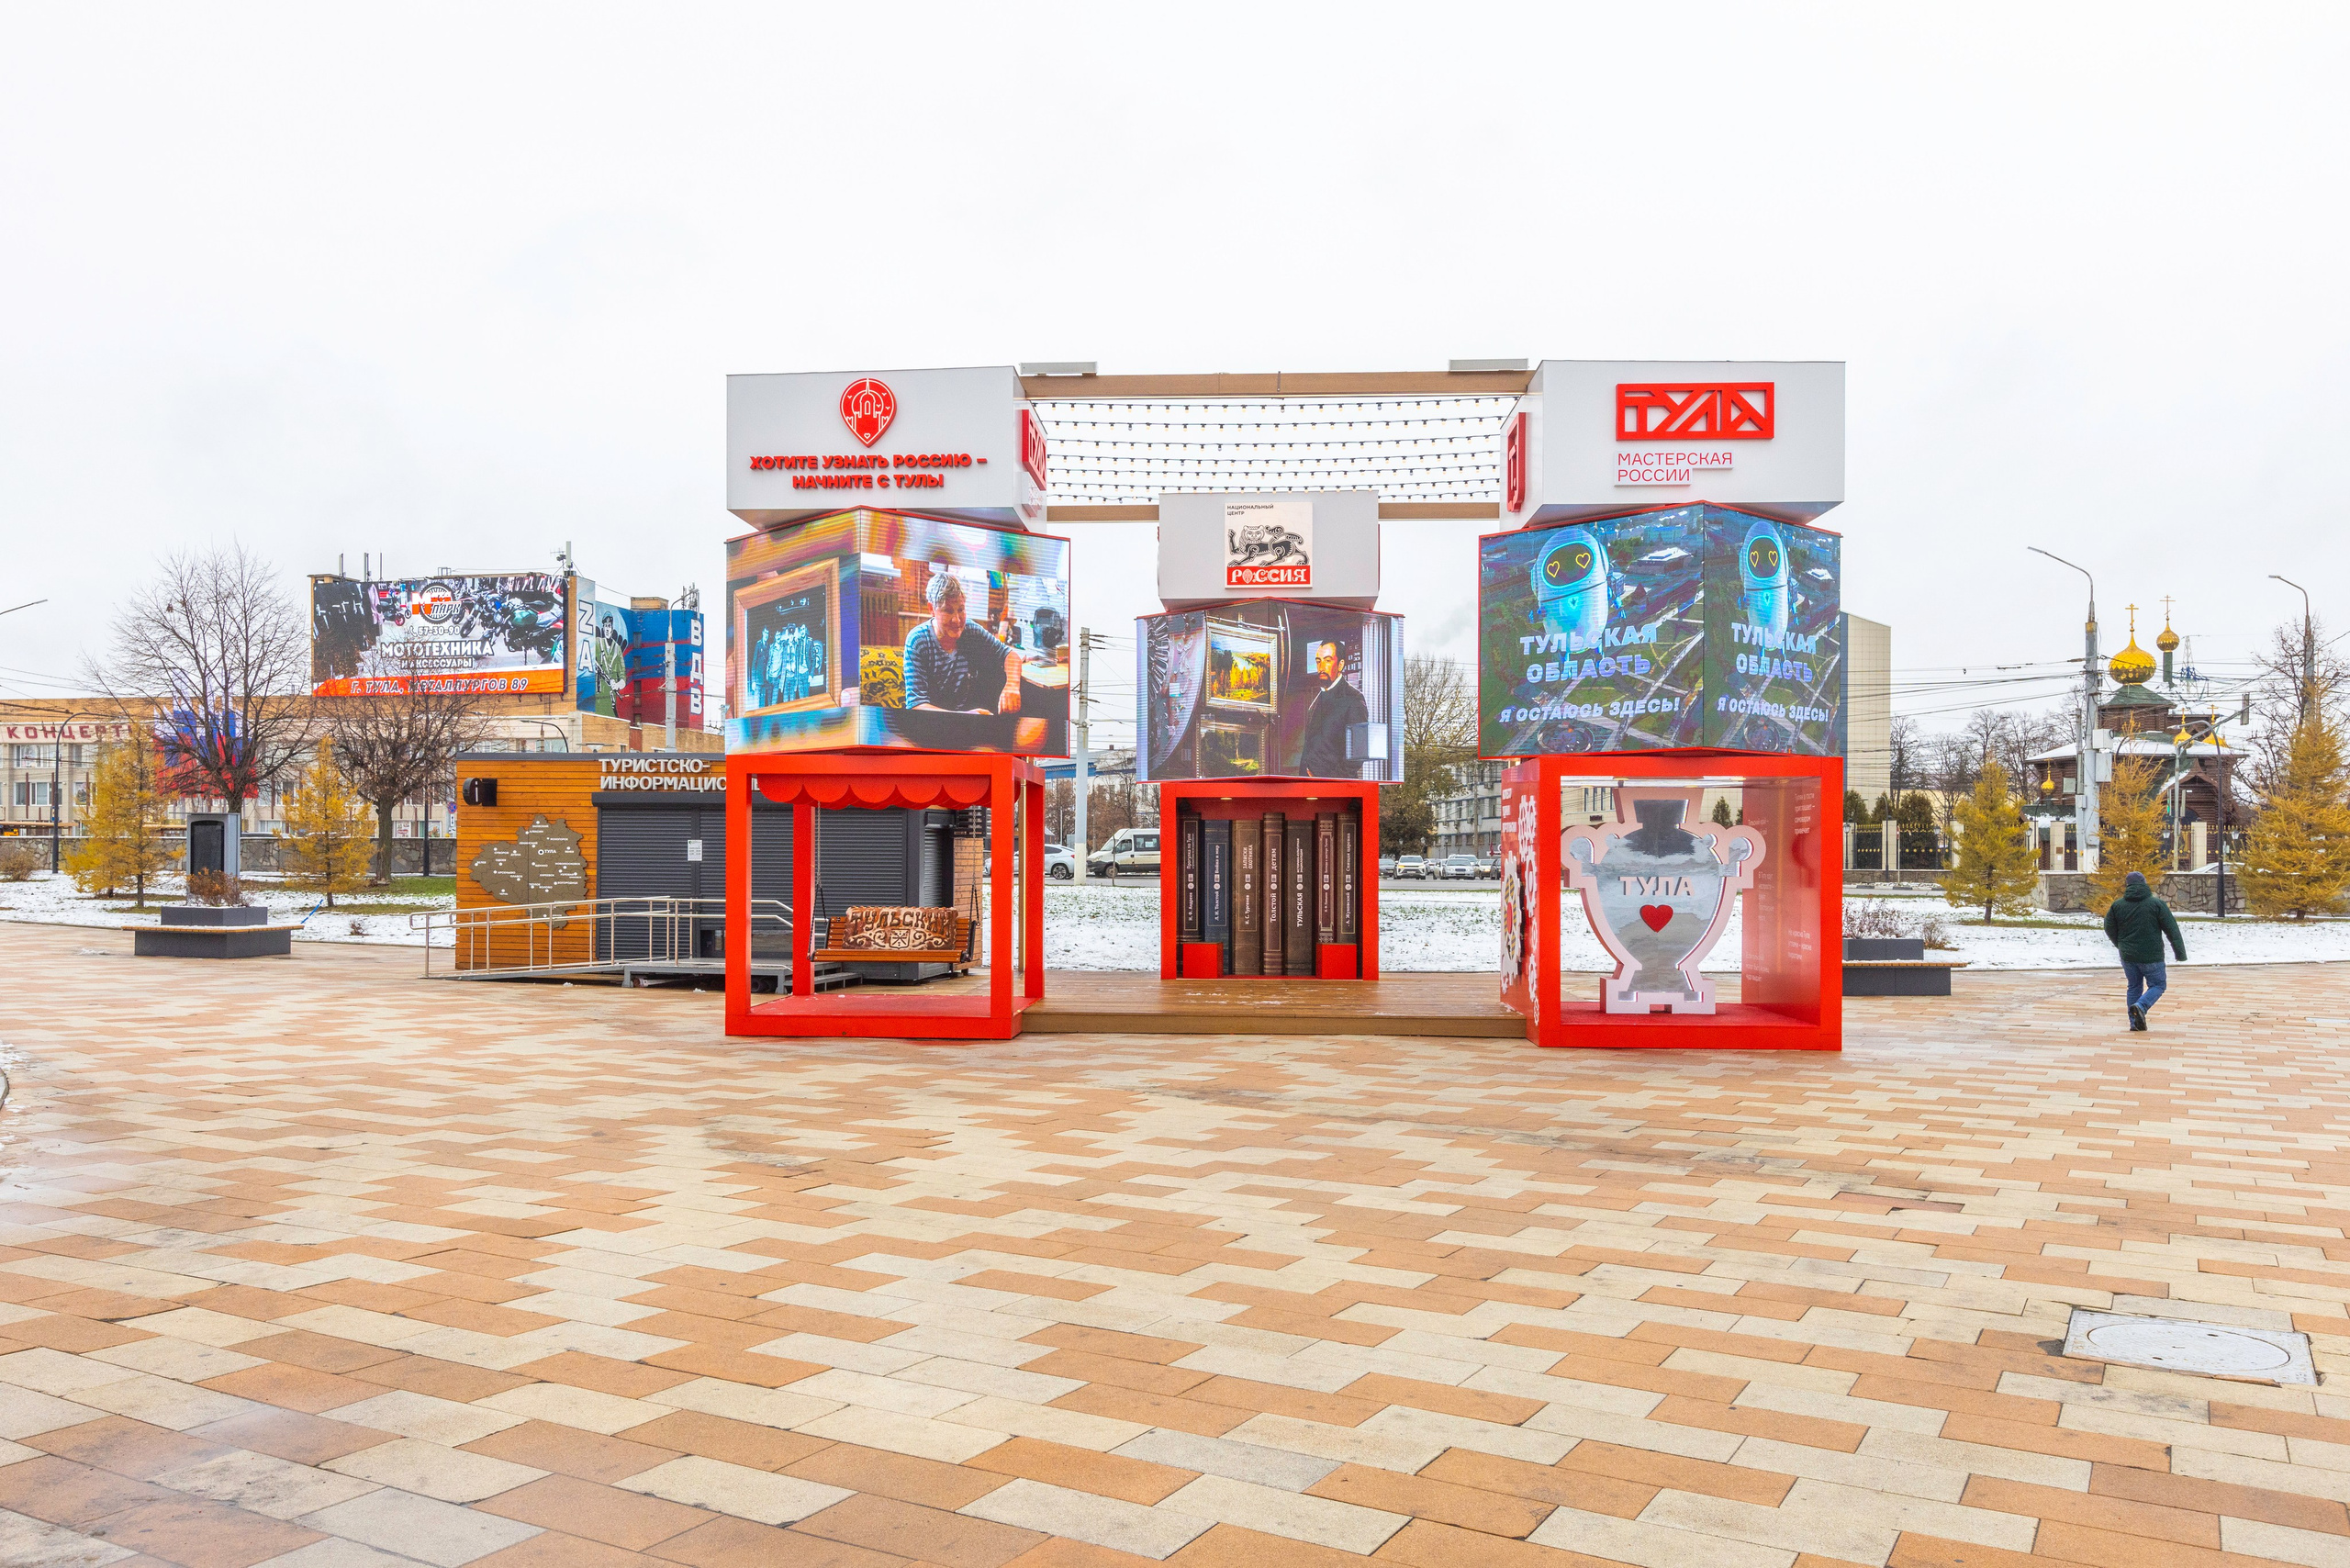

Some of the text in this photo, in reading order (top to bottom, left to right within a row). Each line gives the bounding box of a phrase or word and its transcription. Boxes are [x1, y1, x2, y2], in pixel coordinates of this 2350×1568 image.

[750, 455, 818, 471] ХОТИТЕ
[822, 454, 889, 470] УЗНАТЬ
[893, 454, 972, 468] РОССИЮ
[1617, 452, 1733, 465] МАСТЕРСКАЯ
[792, 474, 945, 489] НАЧНИТЕ С ТУЛЫ
[1617, 468, 1691, 482] РОССИИ
[1230, 568, 1307, 585] РОССИЯ
[418, 626, 460, 636] 57-30-90
[1520, 623, 1658, 655] ТУЛЬСКАЯ
[1731, 622, 1817, 655] ТУЛЬСКАЯ
[380, 641, 495, 657] МОТОТЕХНИКА
[408, 657, 472, 669] АКСЕССУАРЫ
[1527, 655, 1651, 684] ОБЛАСТЬ
[1736, 653, 1813, 682] ОБЛАСТЬ
[366, 679, 404, 694] ТУЛА,
[408, 678, 509, 694] МЕТАЛЛУРГОВ
[511, 678, 529, 690] 89
[1499, 697, 1681, 722] Я ОСТАЮСЬ ЗДЕСЬ!
[1717, 697, 1830, 722] Я ОСТАЮСЬ ЗДЕСЬ!
[599, 758, 711, 773] ТУРИСТСКО-
[599, 776, 760, 792] ИНФОРМАЦИО
[1618, 876, 1695, 896] ТУЛА
